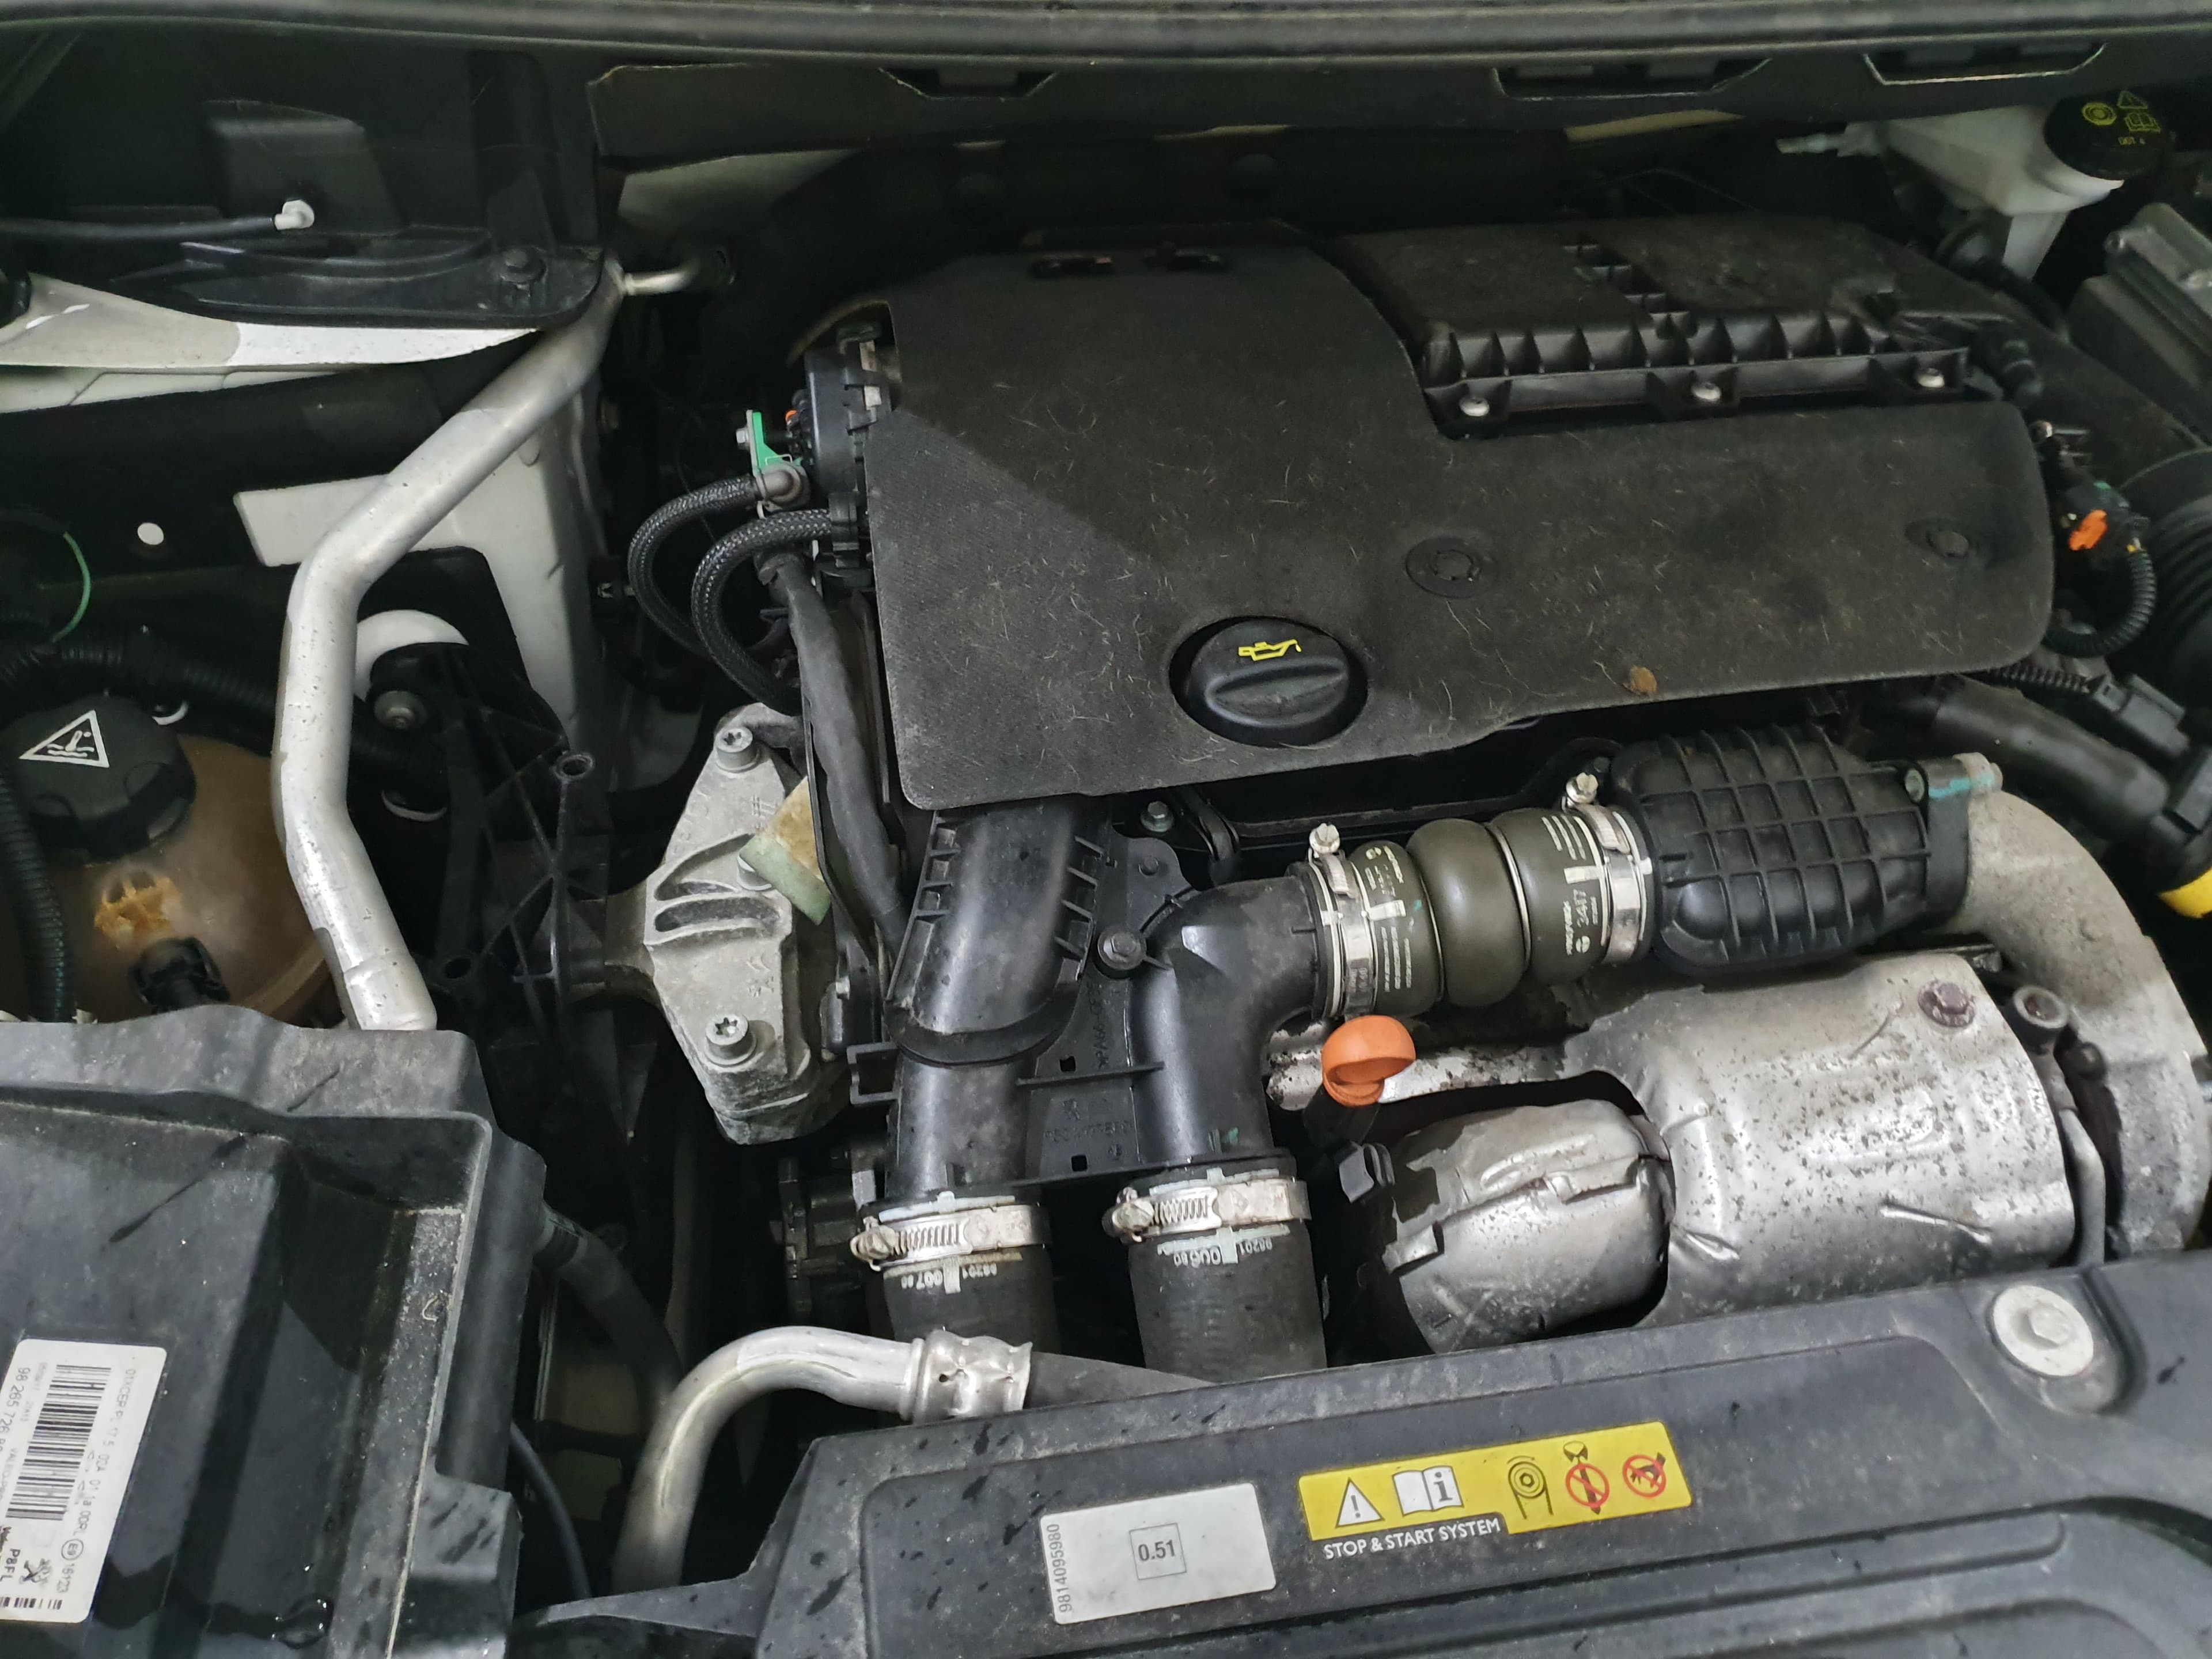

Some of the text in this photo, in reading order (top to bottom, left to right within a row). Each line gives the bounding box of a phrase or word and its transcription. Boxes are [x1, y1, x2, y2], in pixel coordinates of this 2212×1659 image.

[16, 1368, 31, 1381] 98
[6, 1384, 24, 1407] 265
[1138, 1539, 1176, 1561] 0.51
[1324, 1517, 1501, 1559] STOP & START SYSTEM
[0, 1548, 21, 1581] P8FL
[1046, 1524, 1072, 1612] 9814095980
